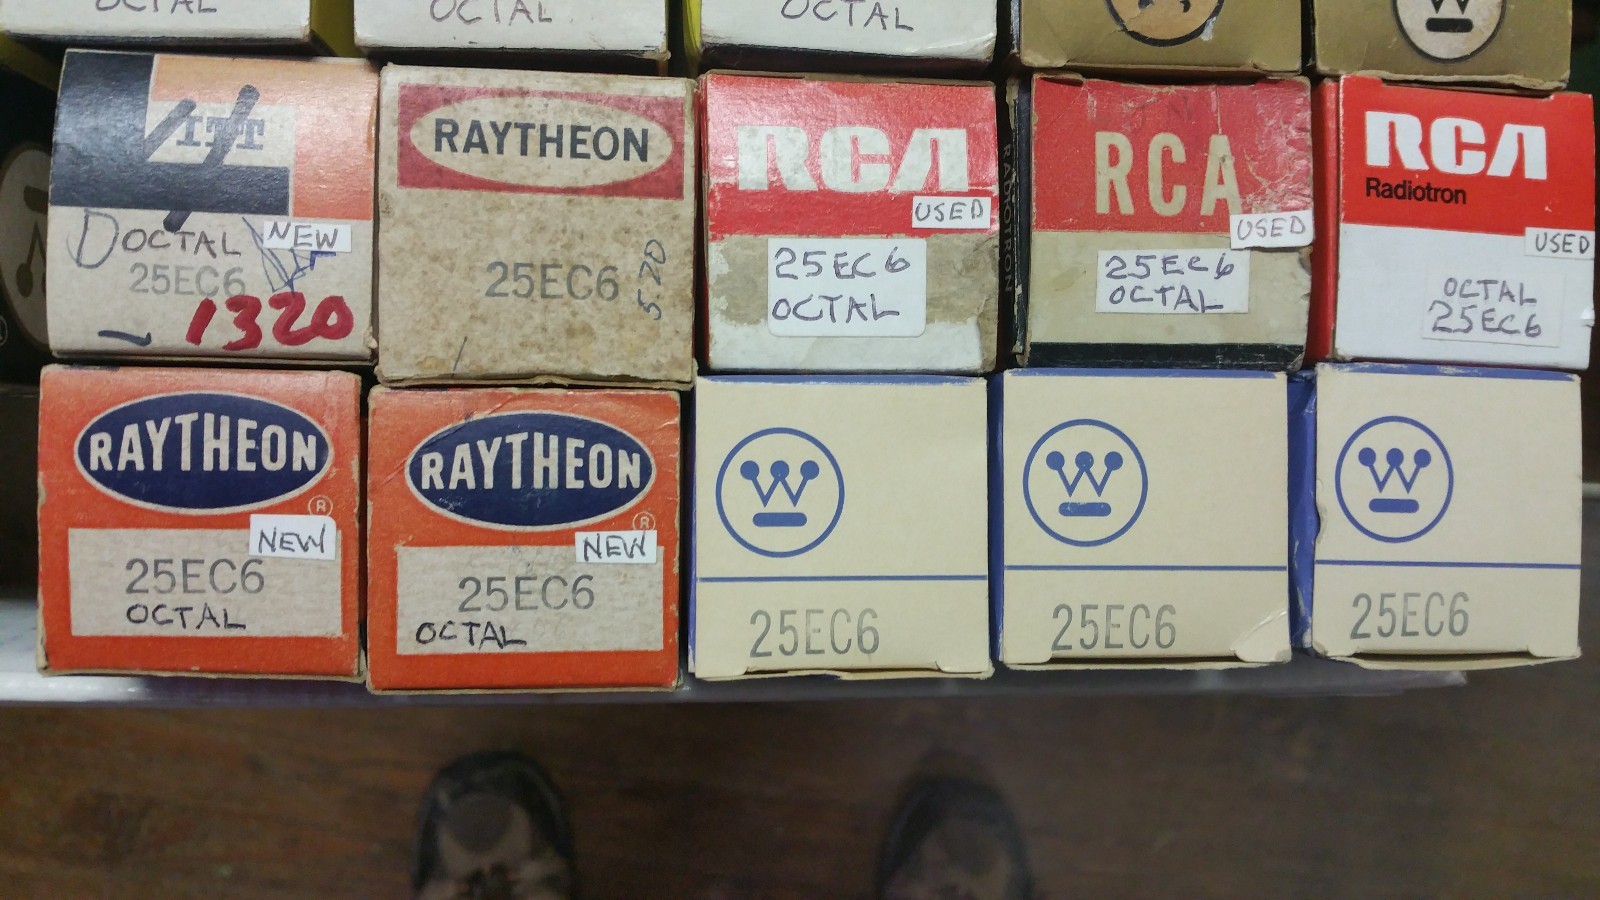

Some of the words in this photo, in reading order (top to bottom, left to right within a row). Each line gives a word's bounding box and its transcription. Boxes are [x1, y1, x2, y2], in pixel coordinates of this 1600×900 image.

[430, 0, 552, 26] OCTAL
[780, 0, 914, 32] OCTAL
[433, 118, 649, 162] RAYTHEON
[1364, 110, 1547, 180] RCA
[737, 125, 969, 193] RCA
[1095, 131, 1243, 217] RCA
[1365, 177, 1467, 205] Radiotron
[914, 202, 985, 222] USED
[1236, 215, 1306, 239] USED
[122, 228, 242, 259] OCTAL
[267, 221, 339, 249] NEW
[1535, 232, 1590, 254] USED
[129, 262, 246, 297] 25EC6
[773, 247, 911, 280] 25EC6
[485, 261, 619, 302] 25EC6
[1443, 277, 1537, 306] OCTAL
[771, 293, 901, 325] OCTAL
[1108, 285, 1224, 313] OCTAL
[186, 291, 354, 351] 1320
[1428, 302, 1542, 338] 25EC6
[89, 412, 319, 474] RAYTHEON
[420, 431, 641, 491] RAYTHEON
[256, 529, 328, 555] NEW
[583, 534, 648, 561] NEW
[125, 558, 265, 595] 25EC6
[457, 574, 595, 612] 25EC6
[126, 602, 247, 631] OCTAL
[1050, 604, 1178, 653] 25EC6
[1350, 591, 1470, 641] 25EC6
[415, 622, 527, 649] OCTAL
[749, 608, 880, 659] 25EC6
